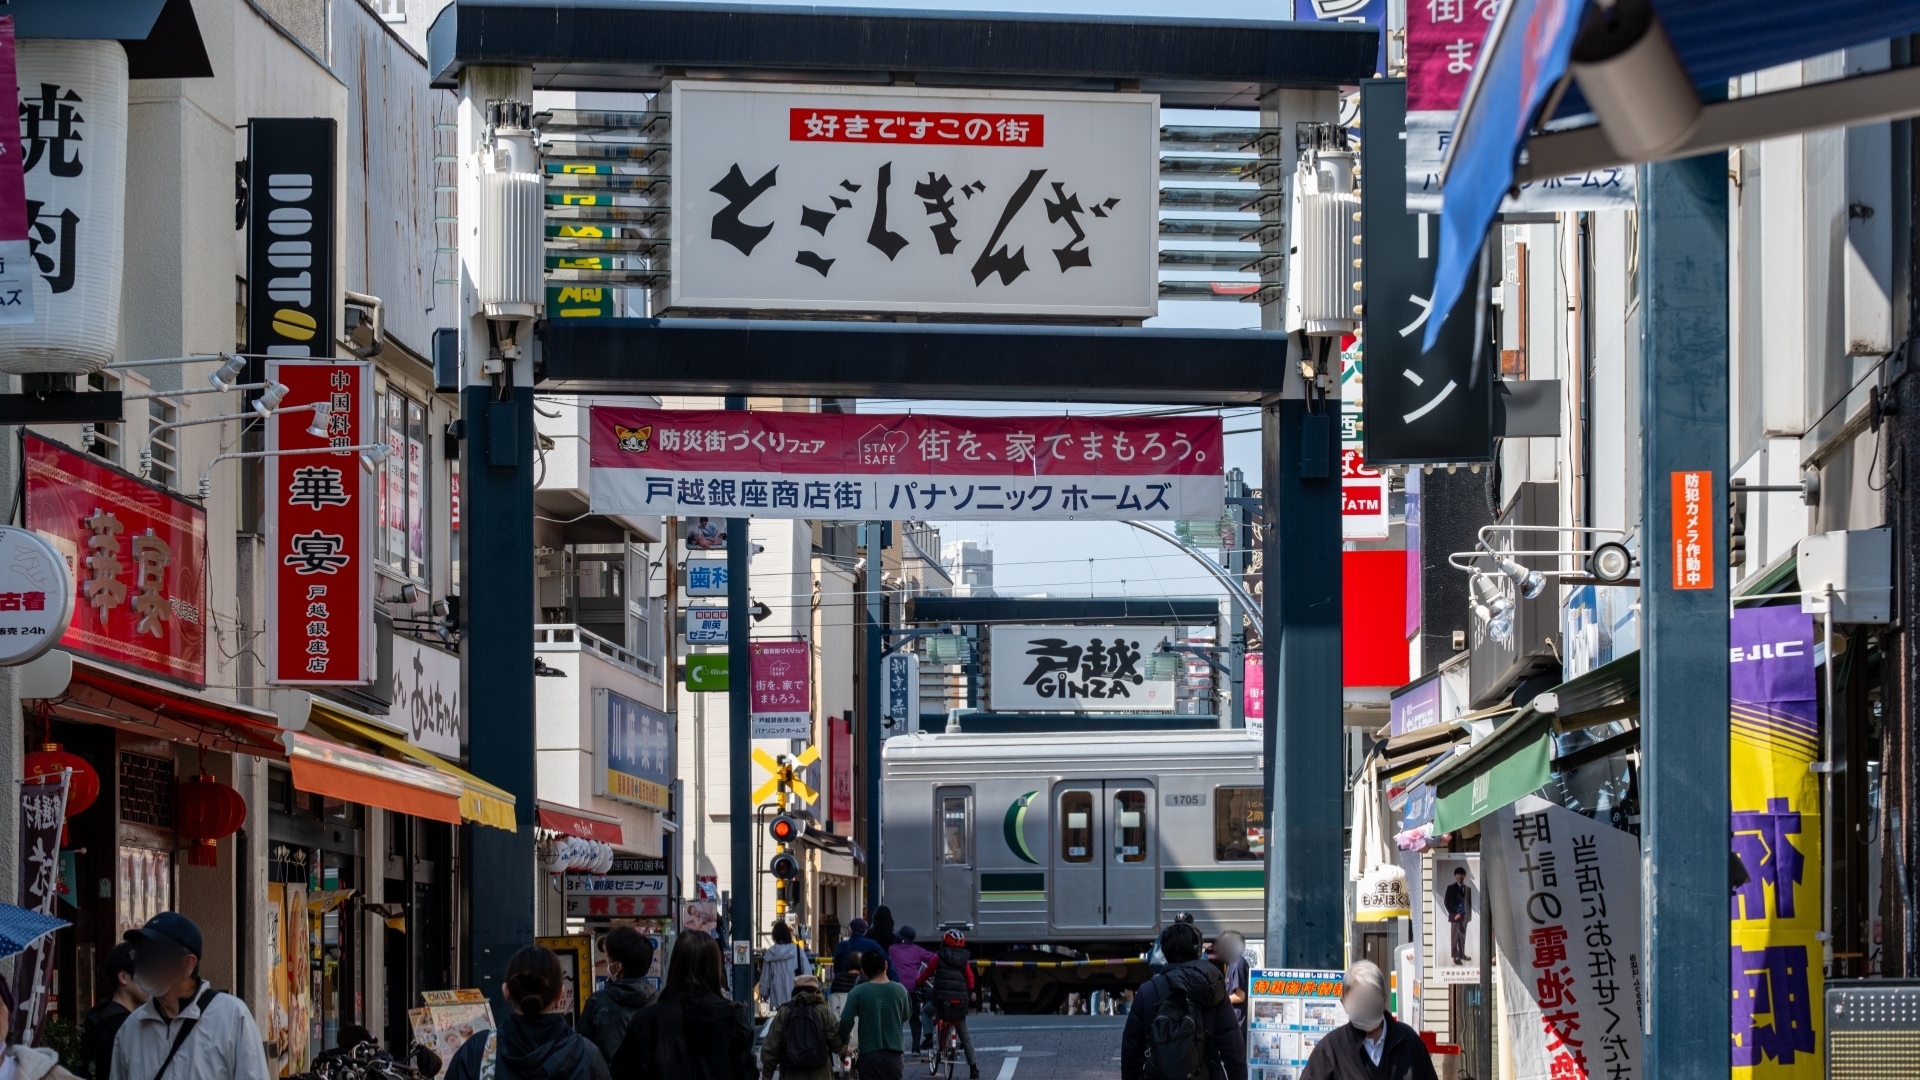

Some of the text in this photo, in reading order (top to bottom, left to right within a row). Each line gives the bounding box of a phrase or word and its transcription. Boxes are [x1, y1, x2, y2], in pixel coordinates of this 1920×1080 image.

[1446, 38, 1473, 74] ま
[804, 111, 1030, 143] 好きですこの街
[708, 160, 1122, 288] とごしぎんざ
[1399, 117, 1458, 424] ーメン
[330, 369, 351, 456] 中国料理
[659, 428, 826, 454] 防災街づくりフェア
[864, 443, 897, 453] STAY
[917, 428, 1206, 462] 街を、家でまもろう。
[864, 455, 896, 465] SAFE
[645, 476, 1173, 511] 戸越銀座商店街 パナソニック ホームズ
[284, 465, 351, 575] 華宴
[1685, 474, 1701, 586] 防犯カメラ作動中
[689, 566, 729, 589] 歯科
[0, 591, 46, 611] 古着
[21, 626, 46, 635] 24h
[306, 584, 330, 673] 戸越銀座店
[702, 620, 722, 629] 創英
[1023, 637, 1144, 686] 戸越
[756, 680, 804, 691] 街を、家で
[1249, 688, 1263, 698] 街
[760, 693, 801, 704] まもろう。
[612, 702, 664, 775] 川崎薬局
[1172, 794, 1199, 805] 1705
[593, 879, 664, 891] 創英ゼミナール
[1376, 880, 1402, 894] 全身
[589, 896, 662, 915] 美容室
